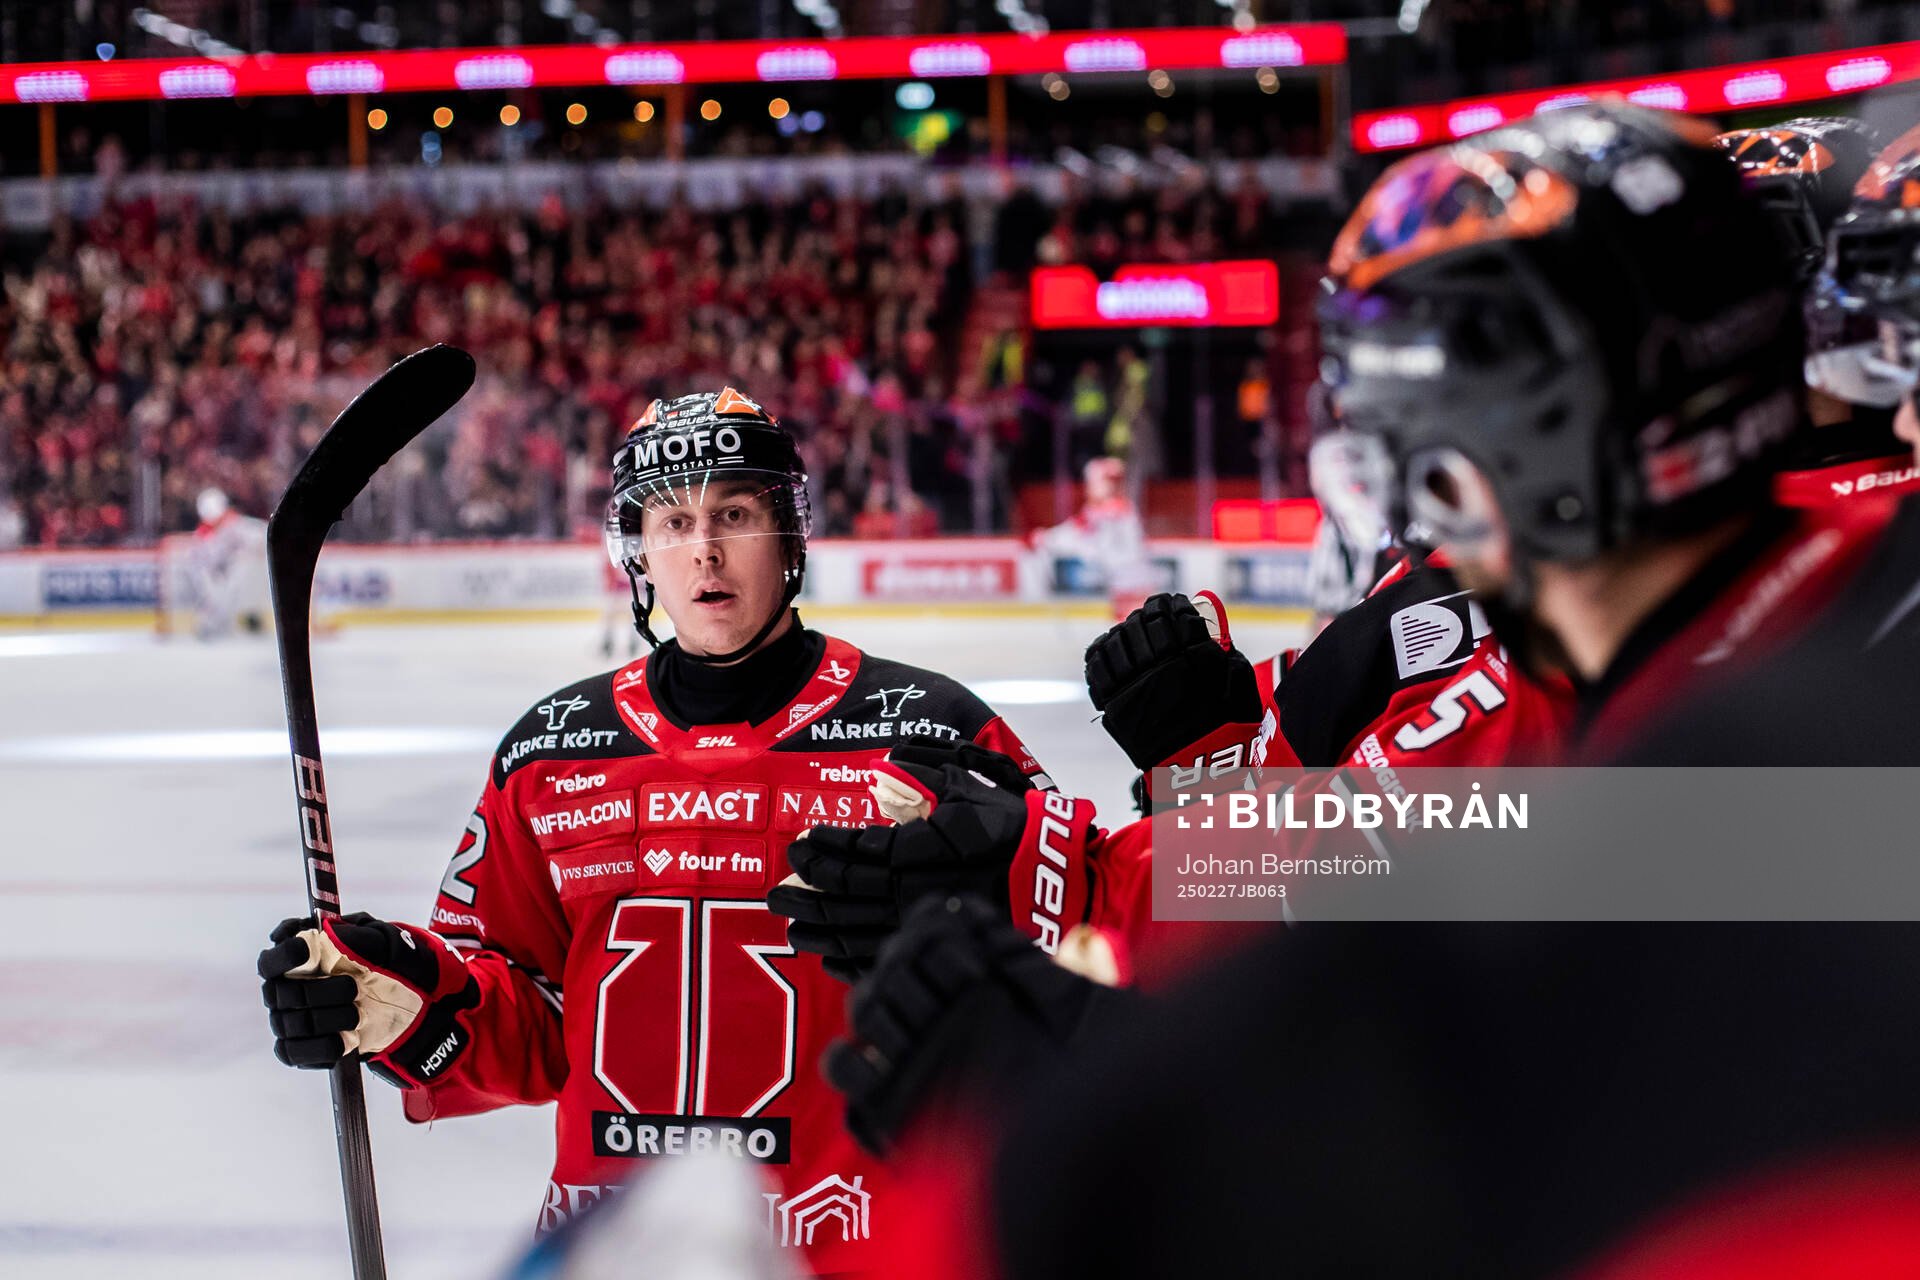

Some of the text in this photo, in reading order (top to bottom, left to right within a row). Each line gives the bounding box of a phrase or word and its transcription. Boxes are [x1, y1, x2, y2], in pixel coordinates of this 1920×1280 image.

[635, 429, 741, 469] MOFO
[664, 459, 713, 473] BOSTAD
[1394, 669, 1506, 752] 5
[695, 735, 736, 748] SHL
[811, 718, 960, 741] NÄRKE KÖTT
[501, 728, 618, 773] NÄRKE KÖTT
[530, 799, 632, 836] INFRA-CON
[648, 788, 760, 822] EXACT
[781, 792, 875, 820] NAST
[562, 861, 635, 881] VVS SERVICE
[679, 851, 763, 872] four fm
[421, 1032, 458, 1076] MACH
[604, 1115, 777, 1158] ÖREBRO
